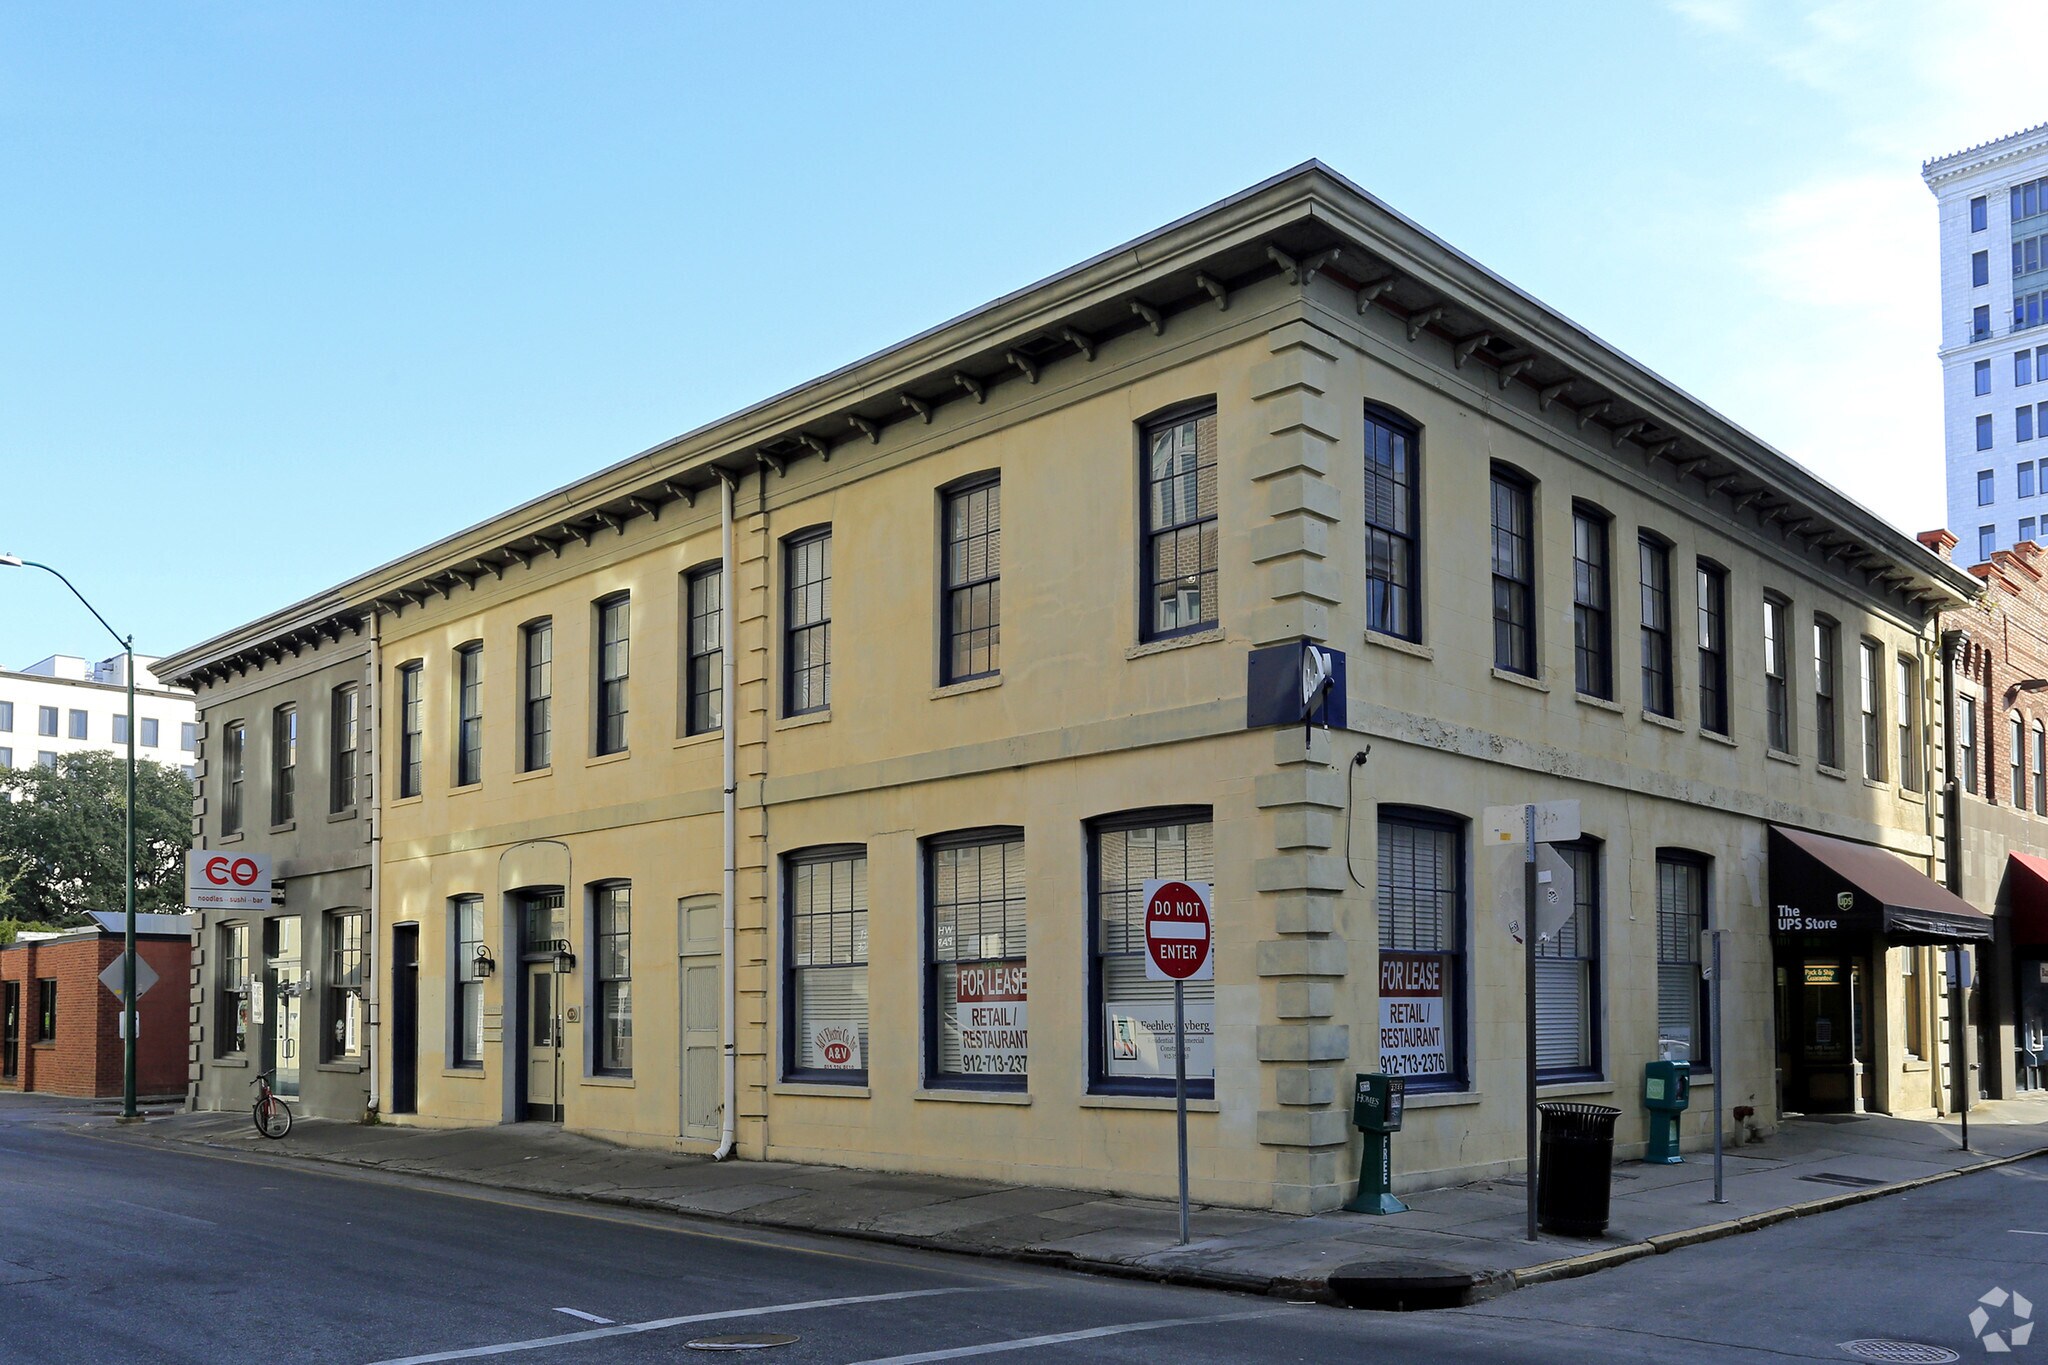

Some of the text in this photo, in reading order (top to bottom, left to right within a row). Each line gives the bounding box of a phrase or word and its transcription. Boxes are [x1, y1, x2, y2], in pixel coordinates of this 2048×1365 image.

[1154, 900, 1200, 917] DO NOT
[1777, 905, 1800, 917] The
[1778, 917, 1837, 930] UPS Store
[1160, 944, 1197, 960] ENTER
[961, 967, 1027, 996] FOR LEASE
[1381, 961, 1440, 990] FOR LEASE
[972, 1008, 1011, 1027] RETAIL
[1390, 1003, 1424, 1024] RETAIL
[1141, 1019, 1211, 1033] Feehley-yberg
[962, 1030, 1028, 1049] RESTAURANT
[1381, 1027, 1440, 1049] RESTAURANT
[828, 1047, 847, 1059] A&V
[963, 1054, 1028, 1073] 912-713-237
[1381, 1053, 1445, 1075] 912-713-2376
